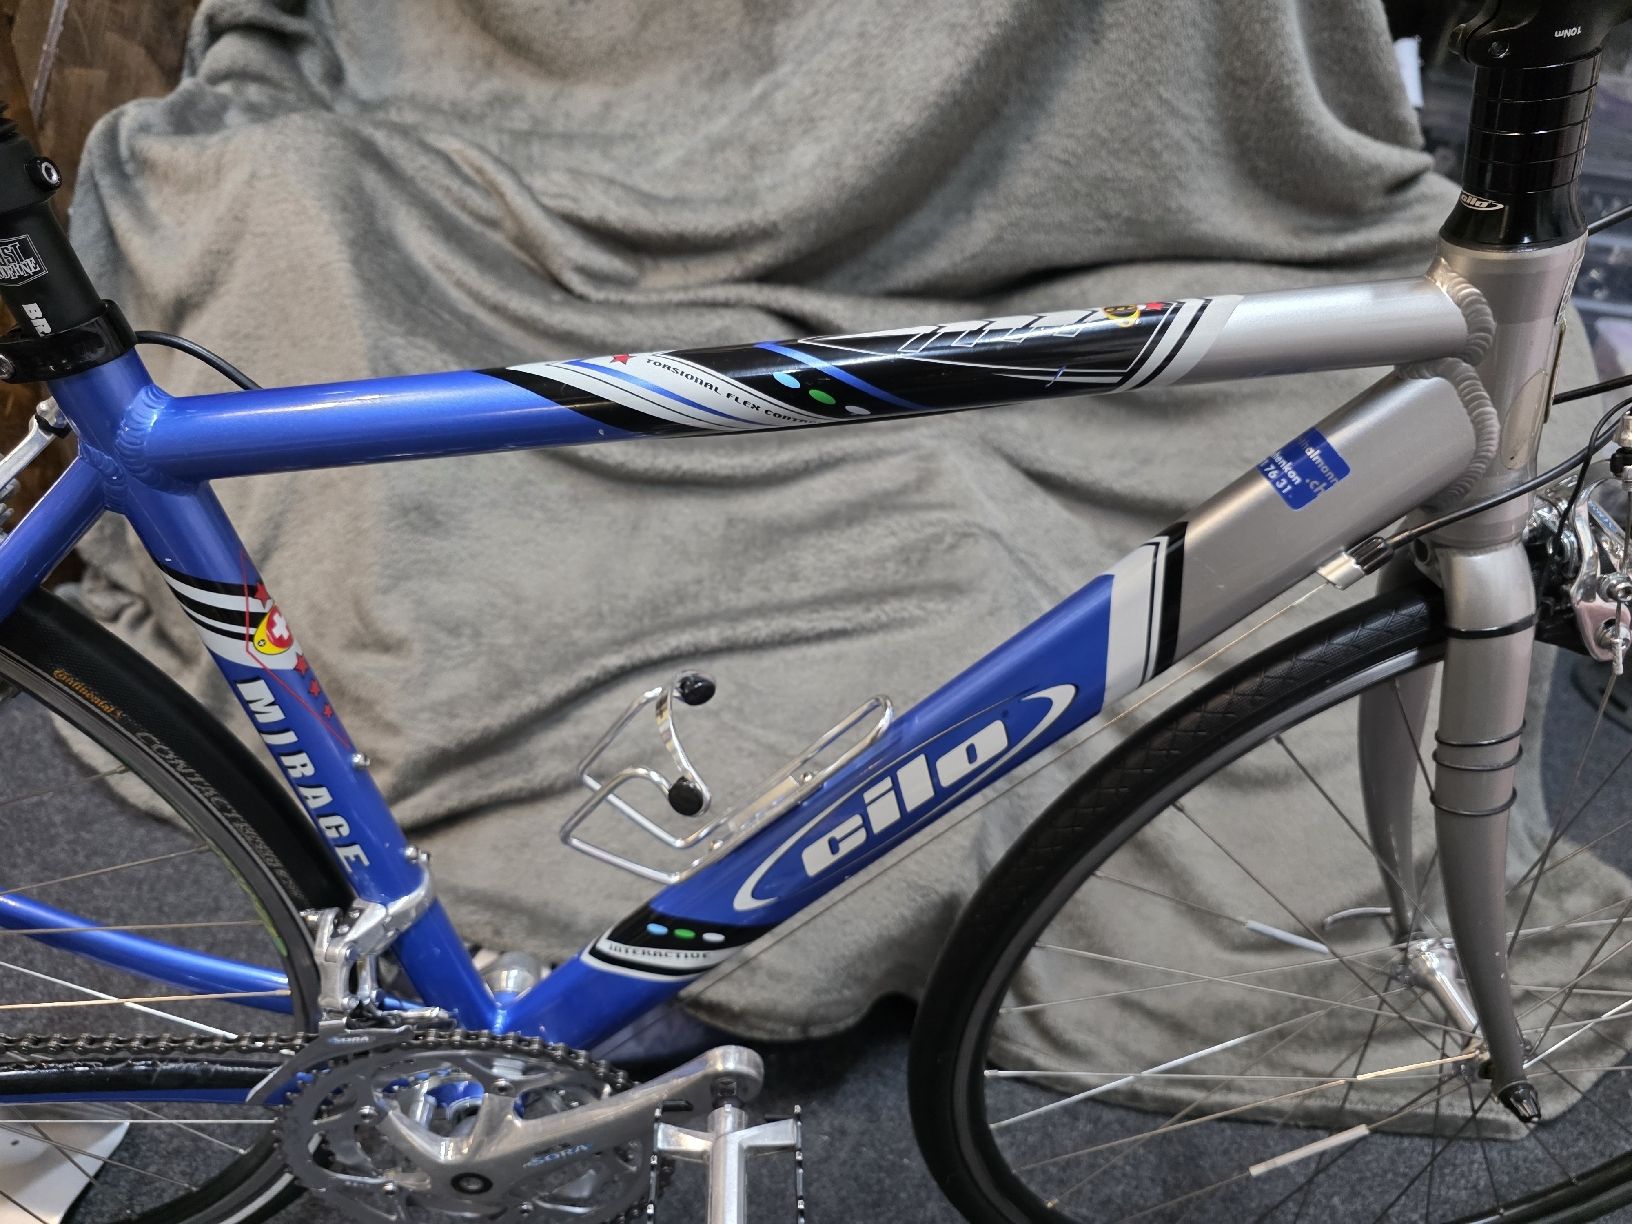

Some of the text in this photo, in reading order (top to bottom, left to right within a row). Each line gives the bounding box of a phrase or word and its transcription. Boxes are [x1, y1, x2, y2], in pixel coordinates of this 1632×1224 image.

[1553, 25, 1582, 39] 10Nm
[646, 358, 722, 396] TORSIONAL
[726, 392, 762, 411] FLEX
[1275, 478, 1292, 494] 31
[235, 677, 370, 873] MIRAGE
[802, 720, 1008, 877] cilo
[608, 943, 709, 959] INTERACTIVE
